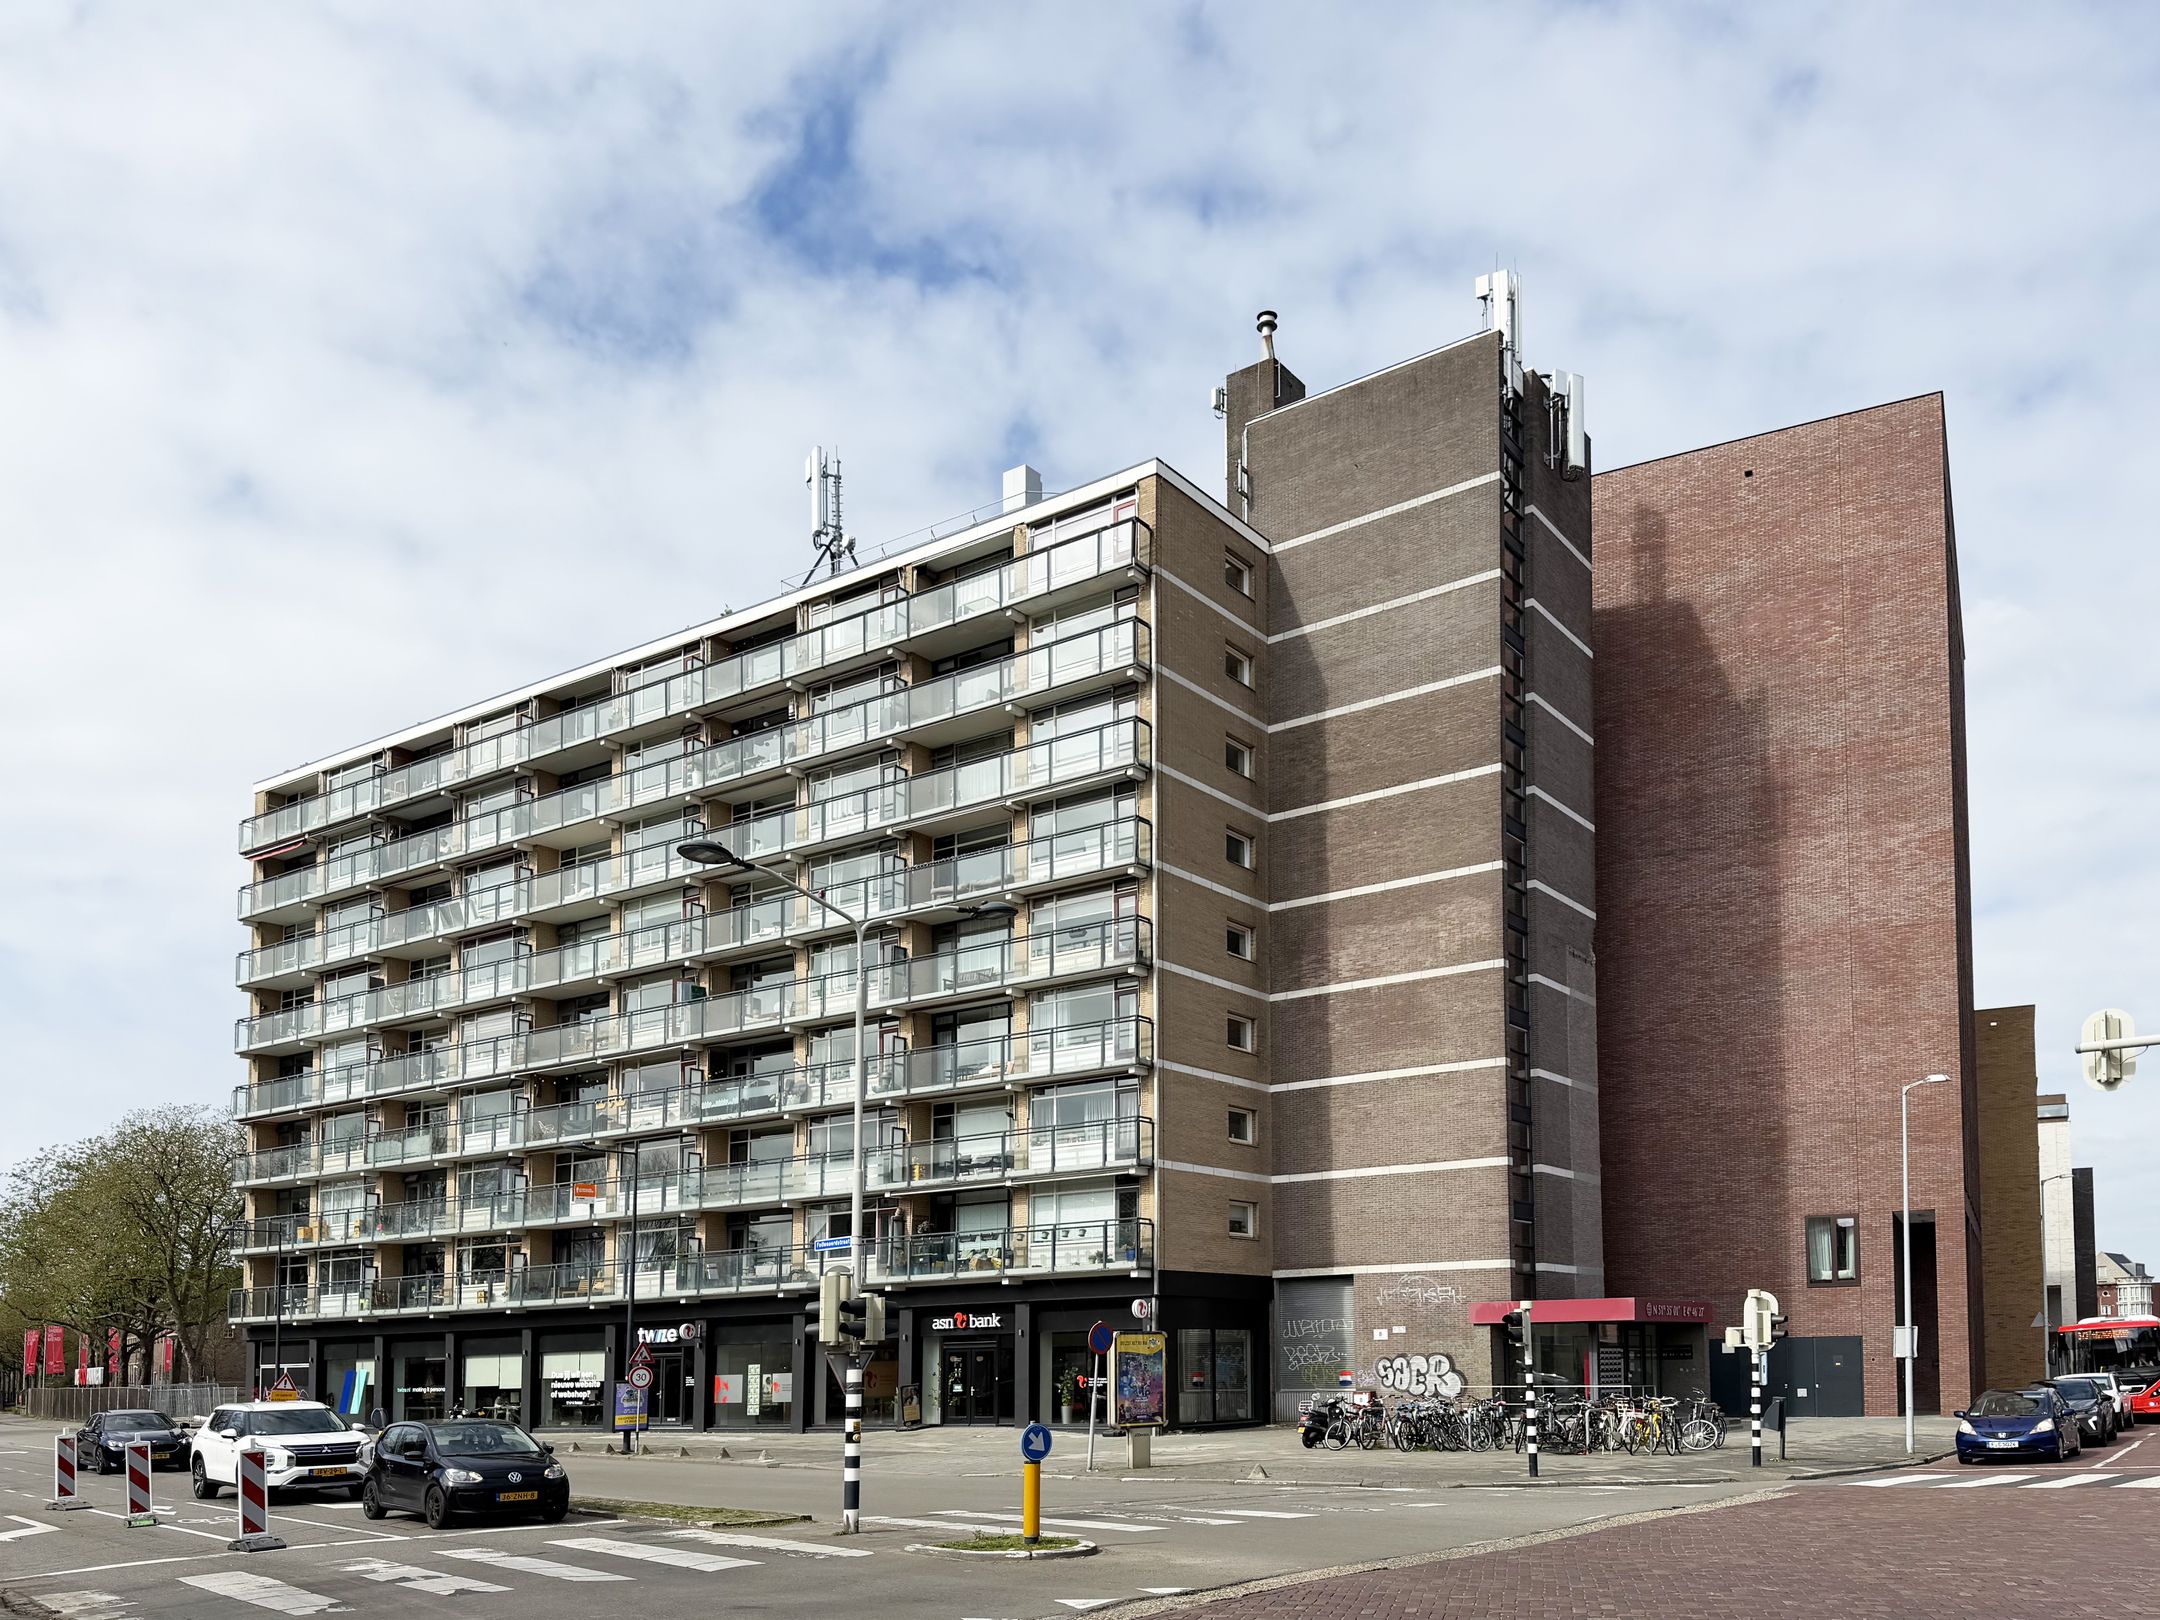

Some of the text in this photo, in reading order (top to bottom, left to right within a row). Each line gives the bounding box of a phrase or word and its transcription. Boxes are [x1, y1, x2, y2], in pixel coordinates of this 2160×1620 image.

[932, 1312, 1001, 1330] asn bank
[635, 1373, 647, 1382] 30
[551, 1379, 601, 1389] nieuwe website
[551, 1390, 591, 1400] of webshop?
